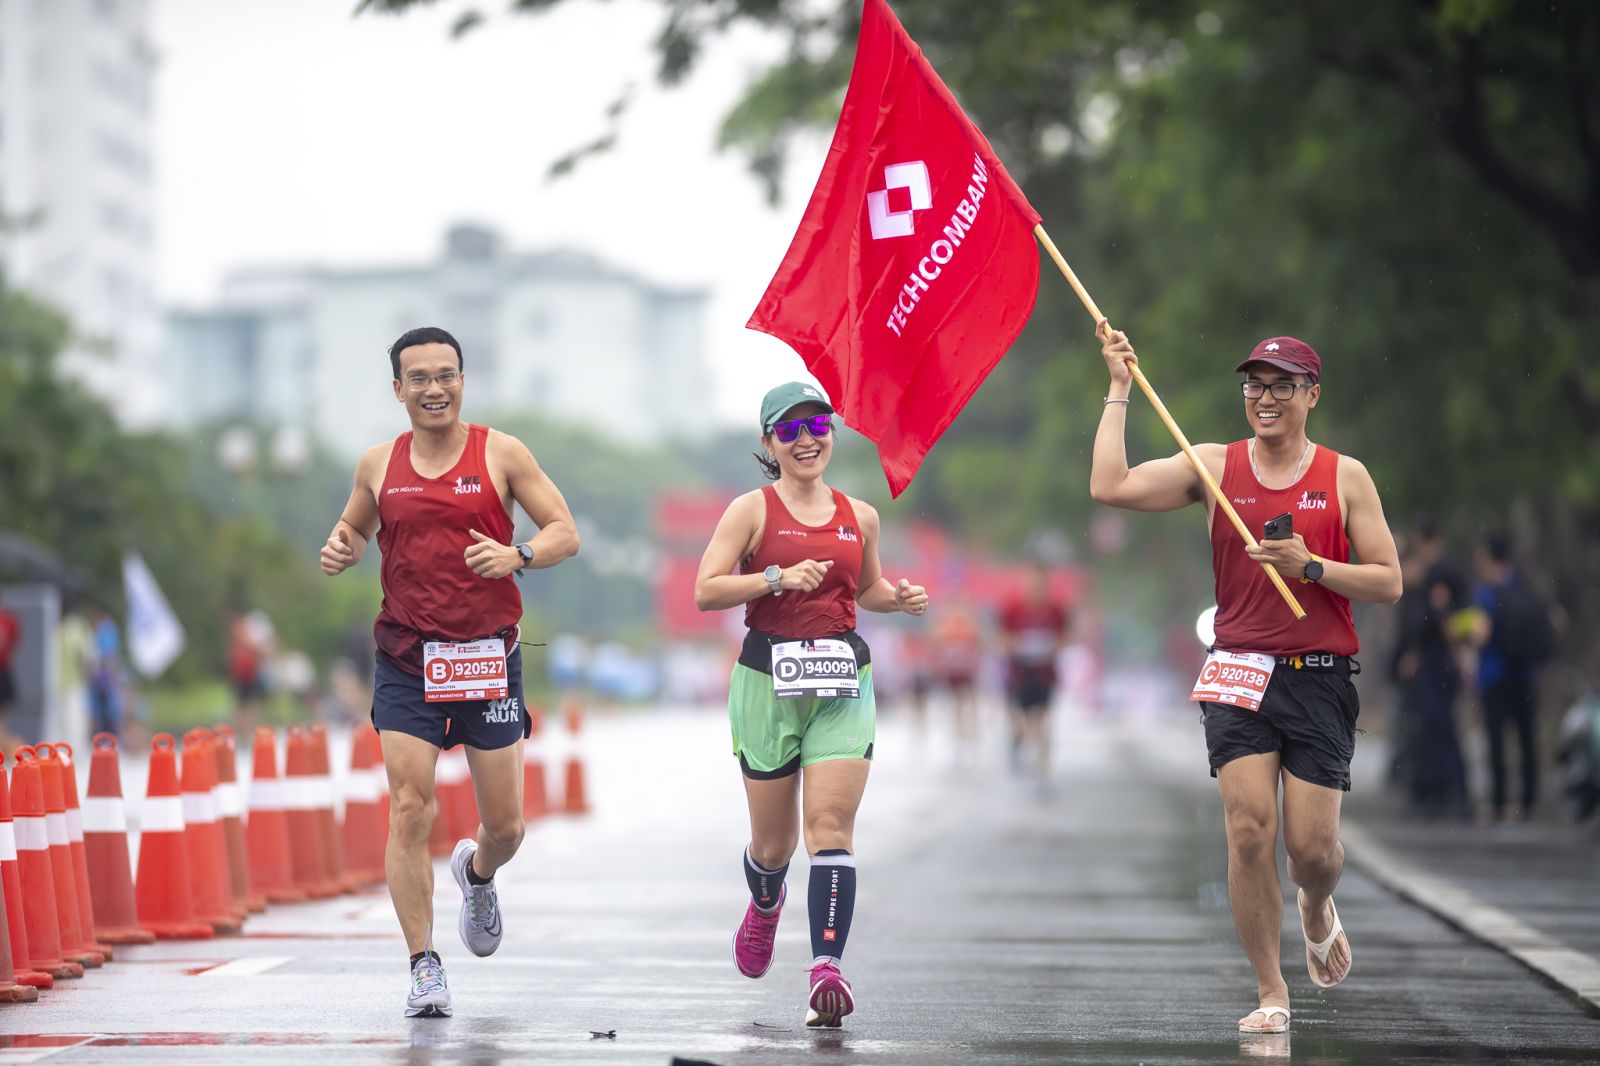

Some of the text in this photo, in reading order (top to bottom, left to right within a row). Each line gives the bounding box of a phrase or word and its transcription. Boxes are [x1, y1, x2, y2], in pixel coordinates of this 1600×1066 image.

[461, 476, 480, 485] WE
[454, 484, 481, 494] RUN
[1307, 492, 1327, 501] WE
[1298, 499, 1327, 510] RUN
[837, 532, 858, 543] RUN
[432, 660, 504, 680] B 920527
[780, 660, 855, 678] D 940091
[1204, 665, 1216, 680] C
[1220, 666, 1266, 686] 920138
[496, 698, 519, 710] WE
[484, 709, 519, 723] RUN
[827, 869, 839, 927] COMPRESSPORT
